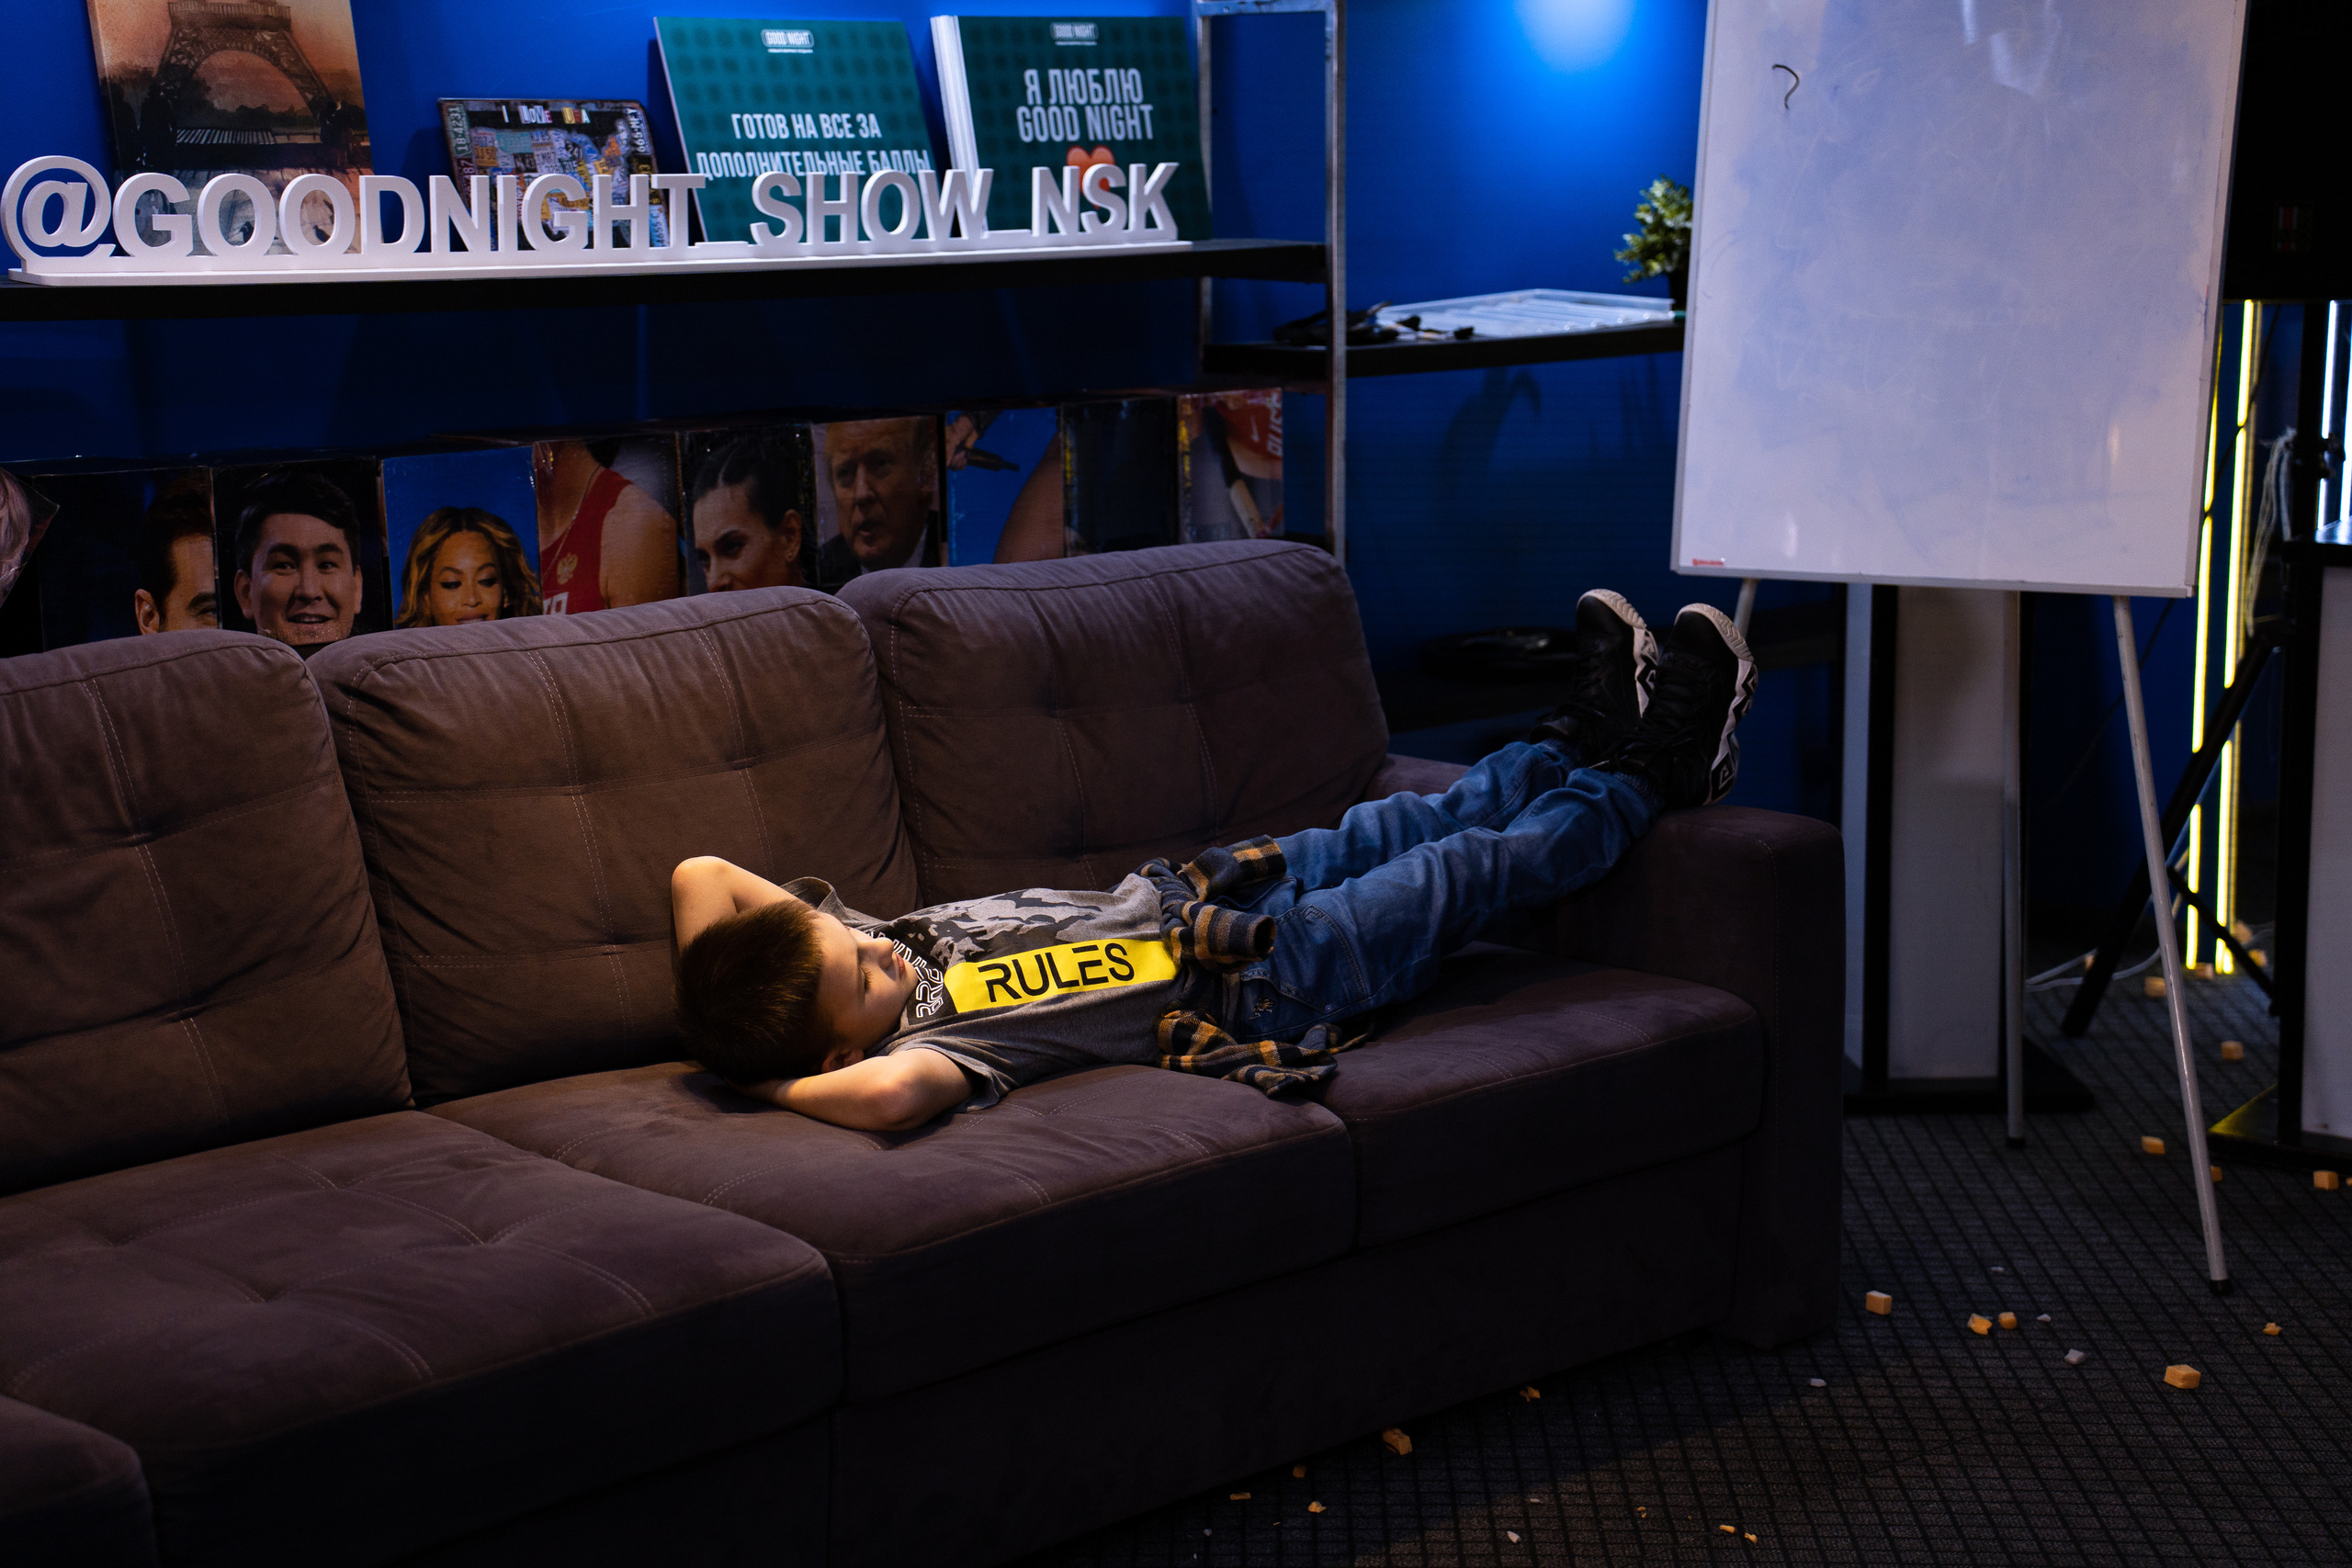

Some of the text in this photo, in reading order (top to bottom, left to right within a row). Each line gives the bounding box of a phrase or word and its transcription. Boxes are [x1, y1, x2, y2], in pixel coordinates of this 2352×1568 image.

[1023, 67, 1145, 106] Я ЛЮБЛЮ
[517, 105, 553, 124] LOVE
[730, 112, 883, 139] ГОТОВ НА ВСЕ ЗА
[1015, 103, 1154, 143] GOOD NIGHT
[695, 149, 930, 181] ДОПОЛНИТЕЛЬНЫЕ БАЛЛЫ
[978, 942, 1135, 1003] RULES
